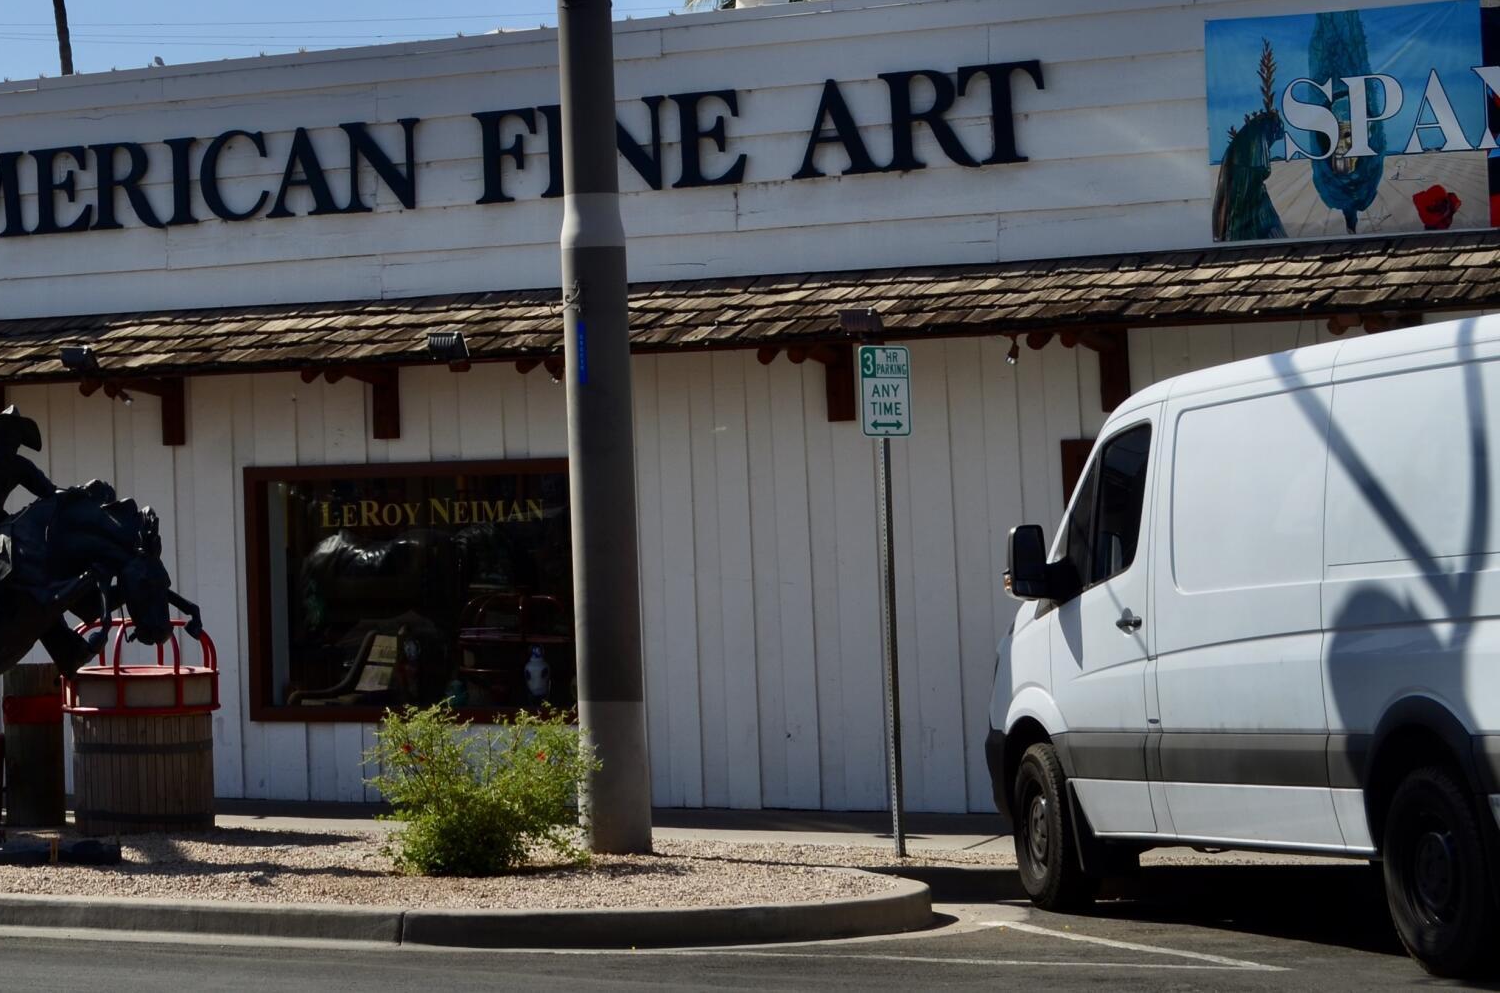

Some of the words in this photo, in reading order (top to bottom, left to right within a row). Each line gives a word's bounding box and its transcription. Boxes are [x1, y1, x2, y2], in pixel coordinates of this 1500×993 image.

[792, 60, 1045, 179] ART
[863, 352, 873, 375] 3
[886, 352, 898, 363] HR
[877, 363, 907, 375] PARKING
[871, 384, 900, 397] ANY
[871, 402, 902, 416] TIME
